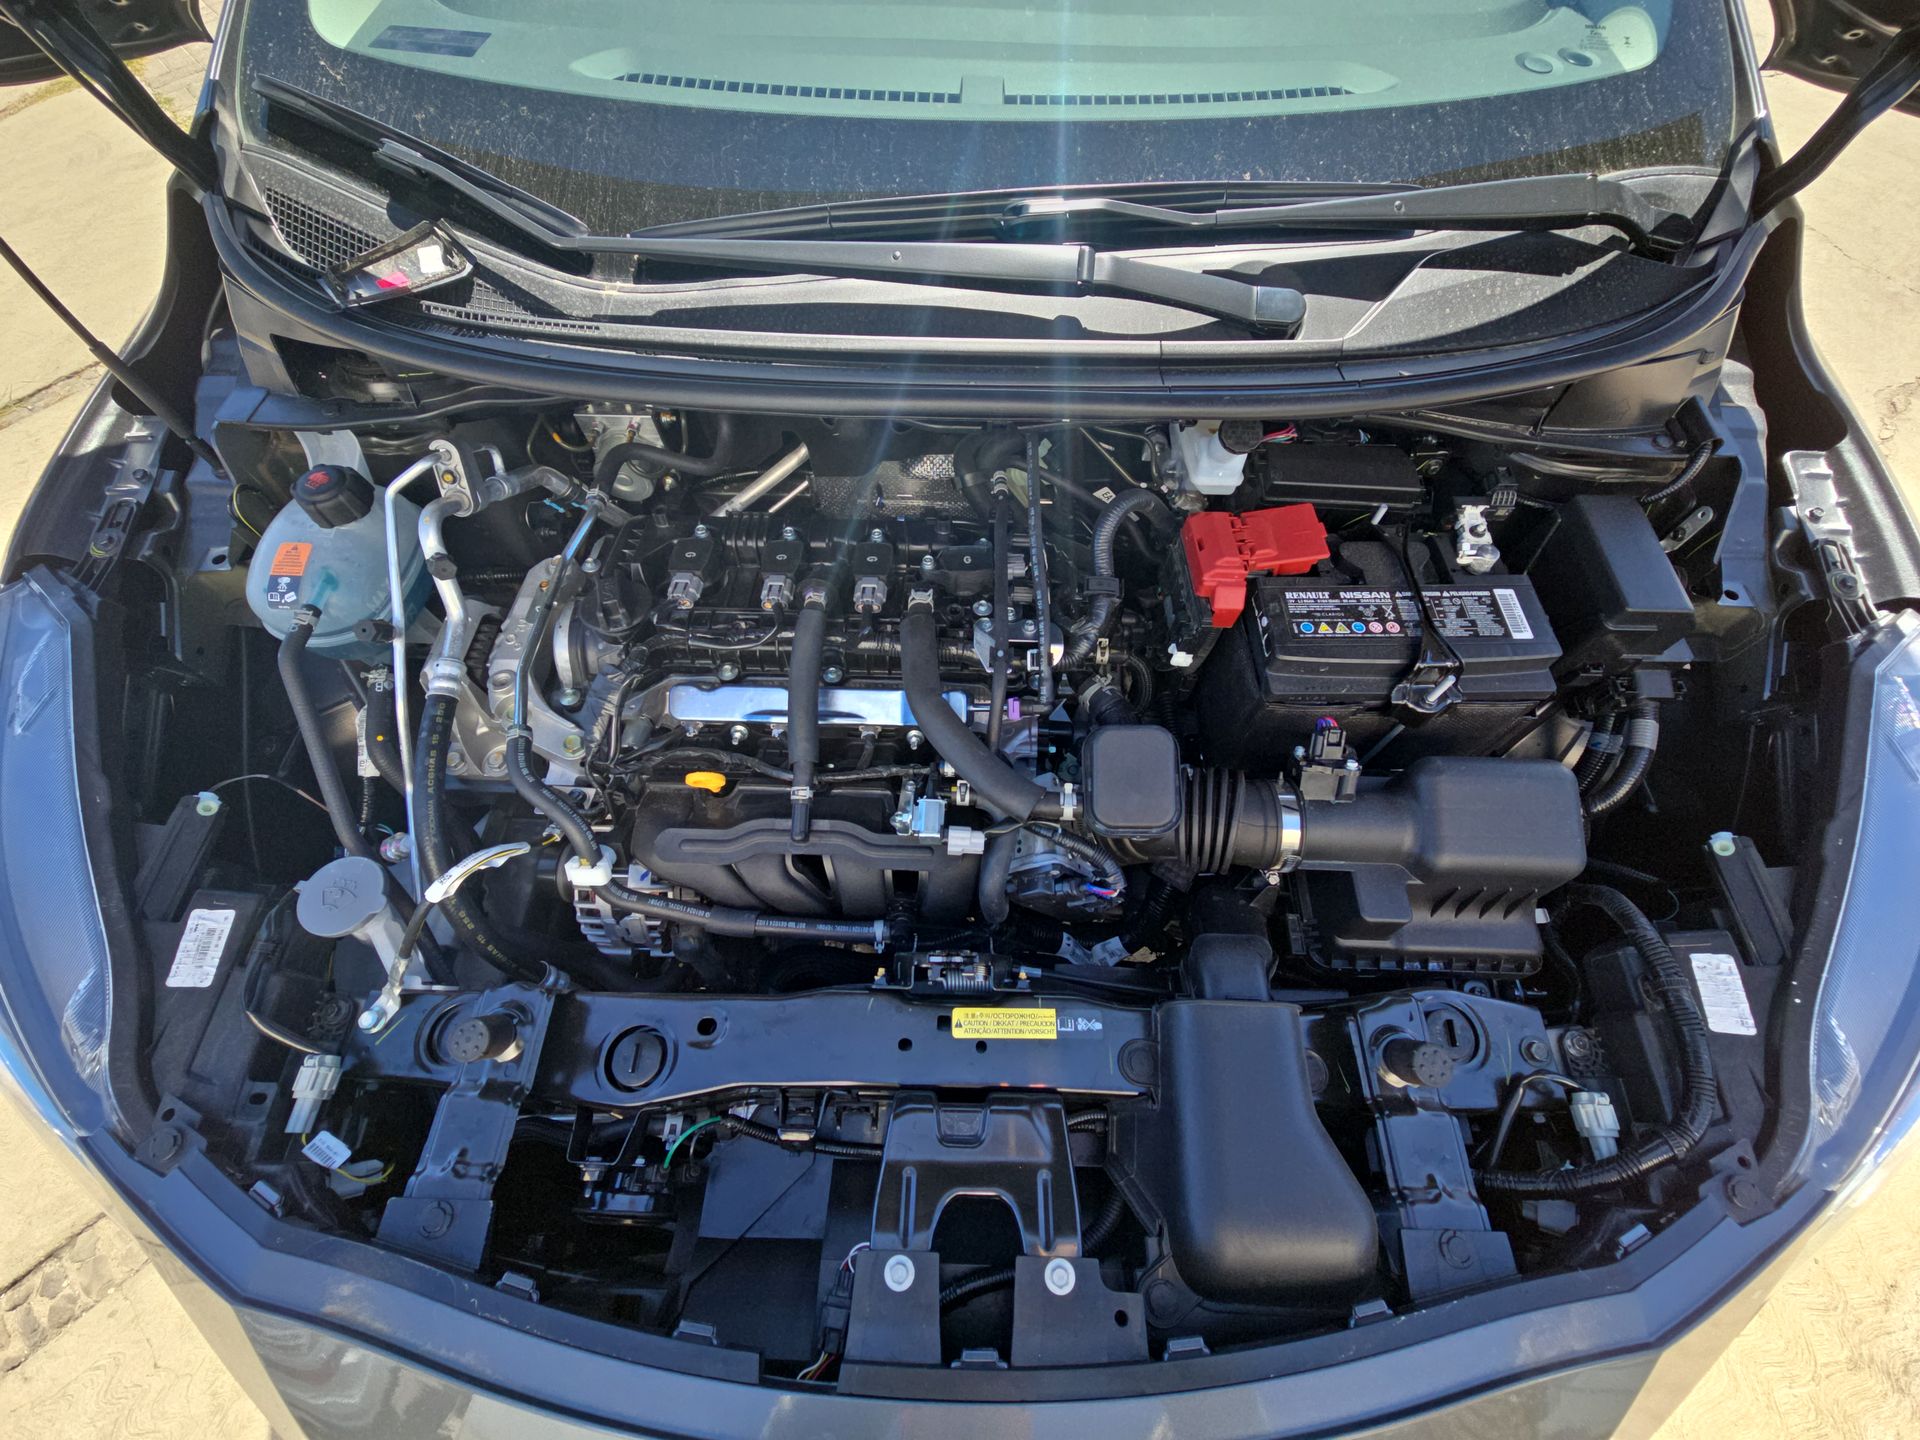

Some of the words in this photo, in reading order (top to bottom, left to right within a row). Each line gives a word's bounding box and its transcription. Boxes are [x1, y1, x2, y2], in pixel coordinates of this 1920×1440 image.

[963, 555, 972, 564] G
[1284, 591, 1330, 599] RENAULT
[1339, 591, 1391, 599] NISSAN
[431, 733, 440, 745] 15
